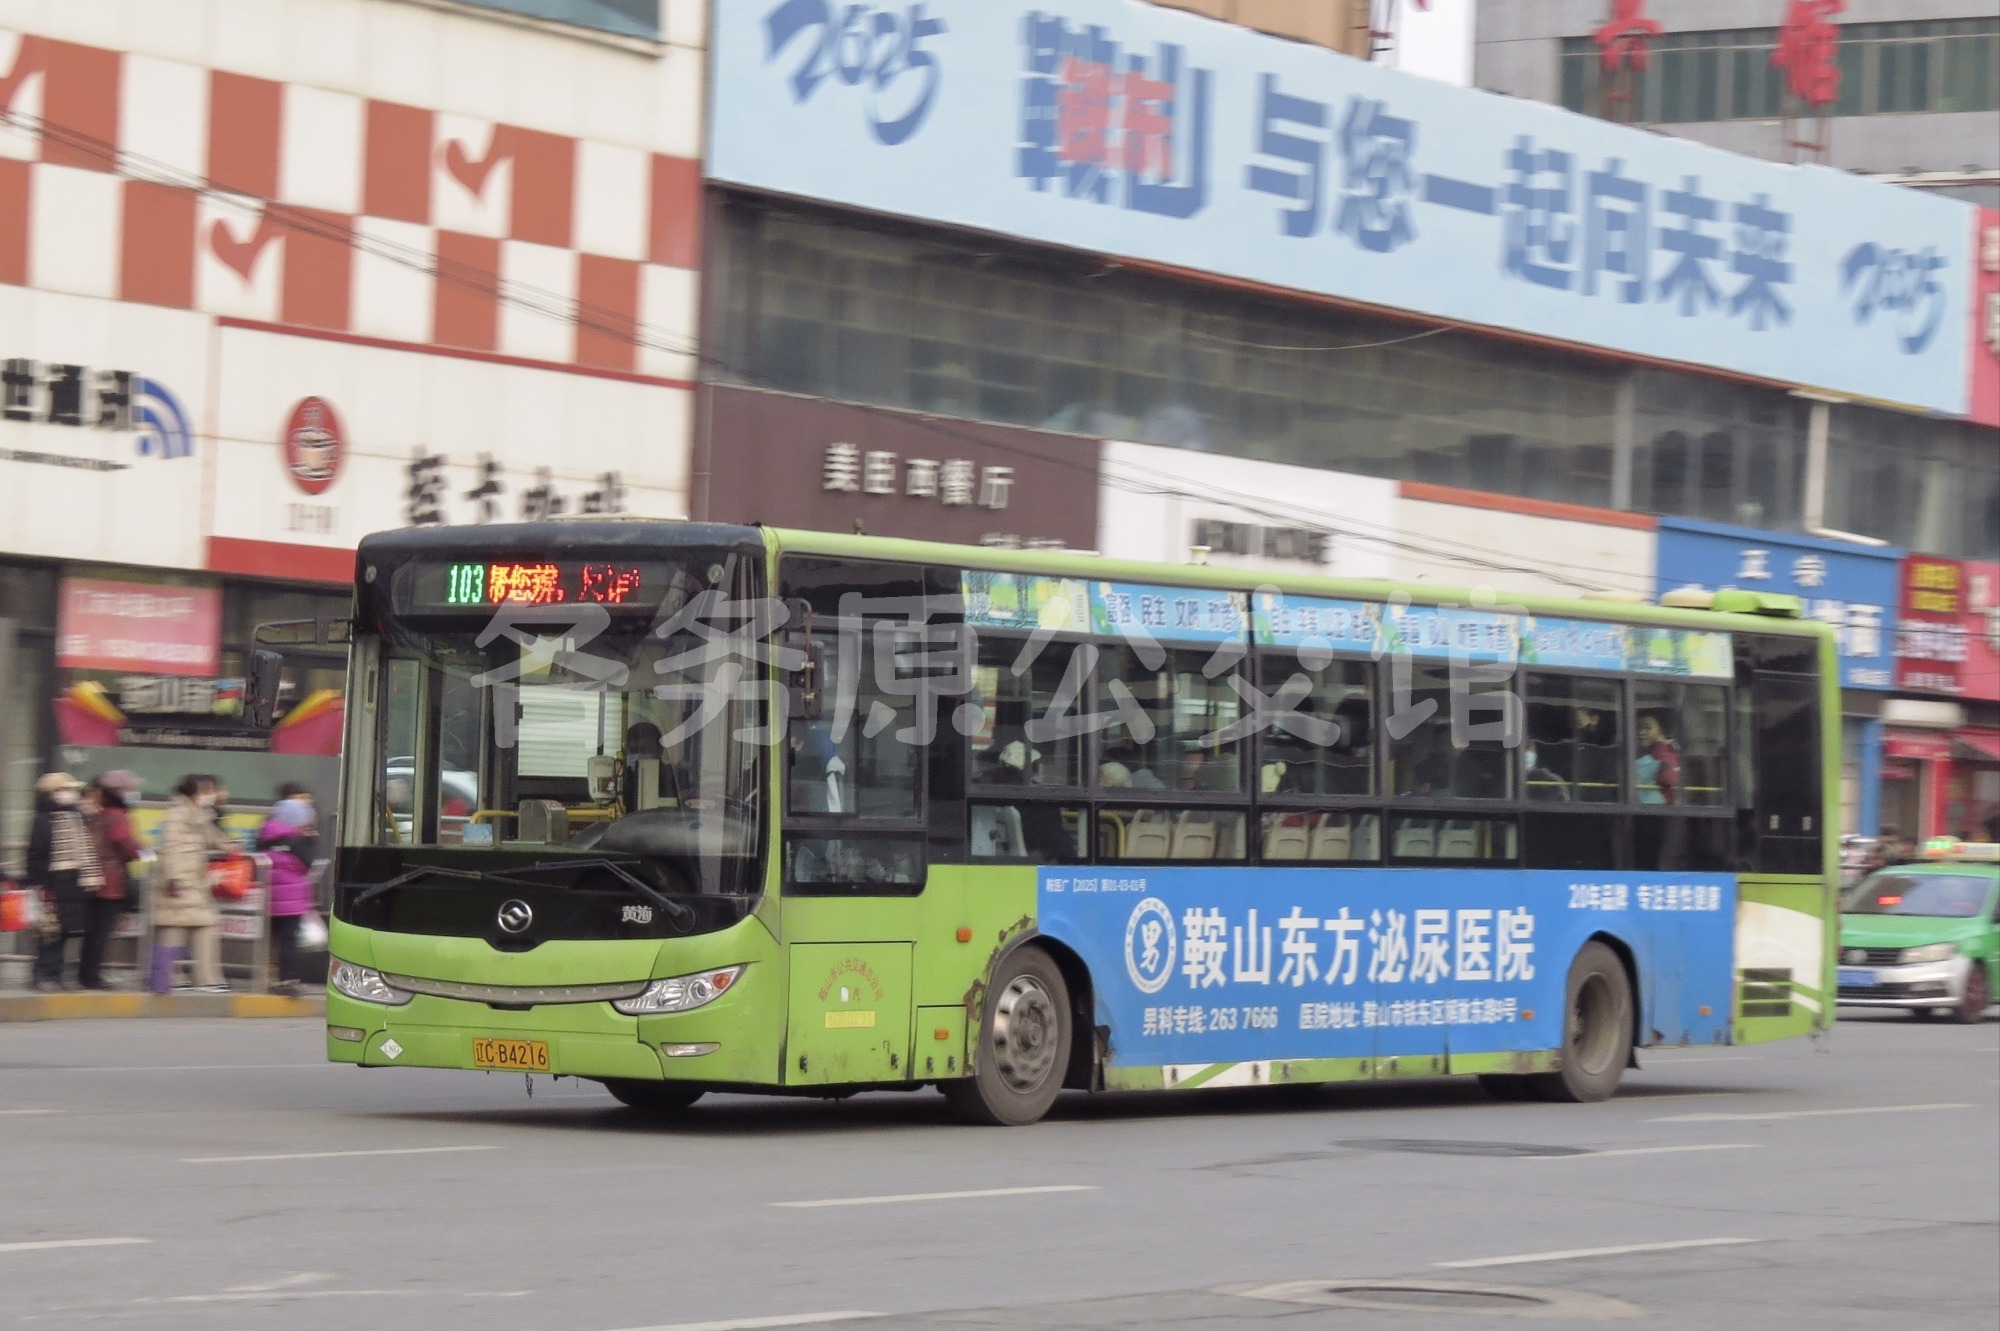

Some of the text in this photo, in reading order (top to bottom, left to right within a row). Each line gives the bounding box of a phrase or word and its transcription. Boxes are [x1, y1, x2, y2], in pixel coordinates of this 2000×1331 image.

[448, 564, 484, 603] 103
[622, 905, 652, 923] 黄海
[1182, 906, 1535, 989] 鞍山东方泌尿医院
[1209, 1008, 1237, 1031] 263
[1242, 1006, 1278, 1029] 7666
[384, 1044, 399, 1054] LNG
